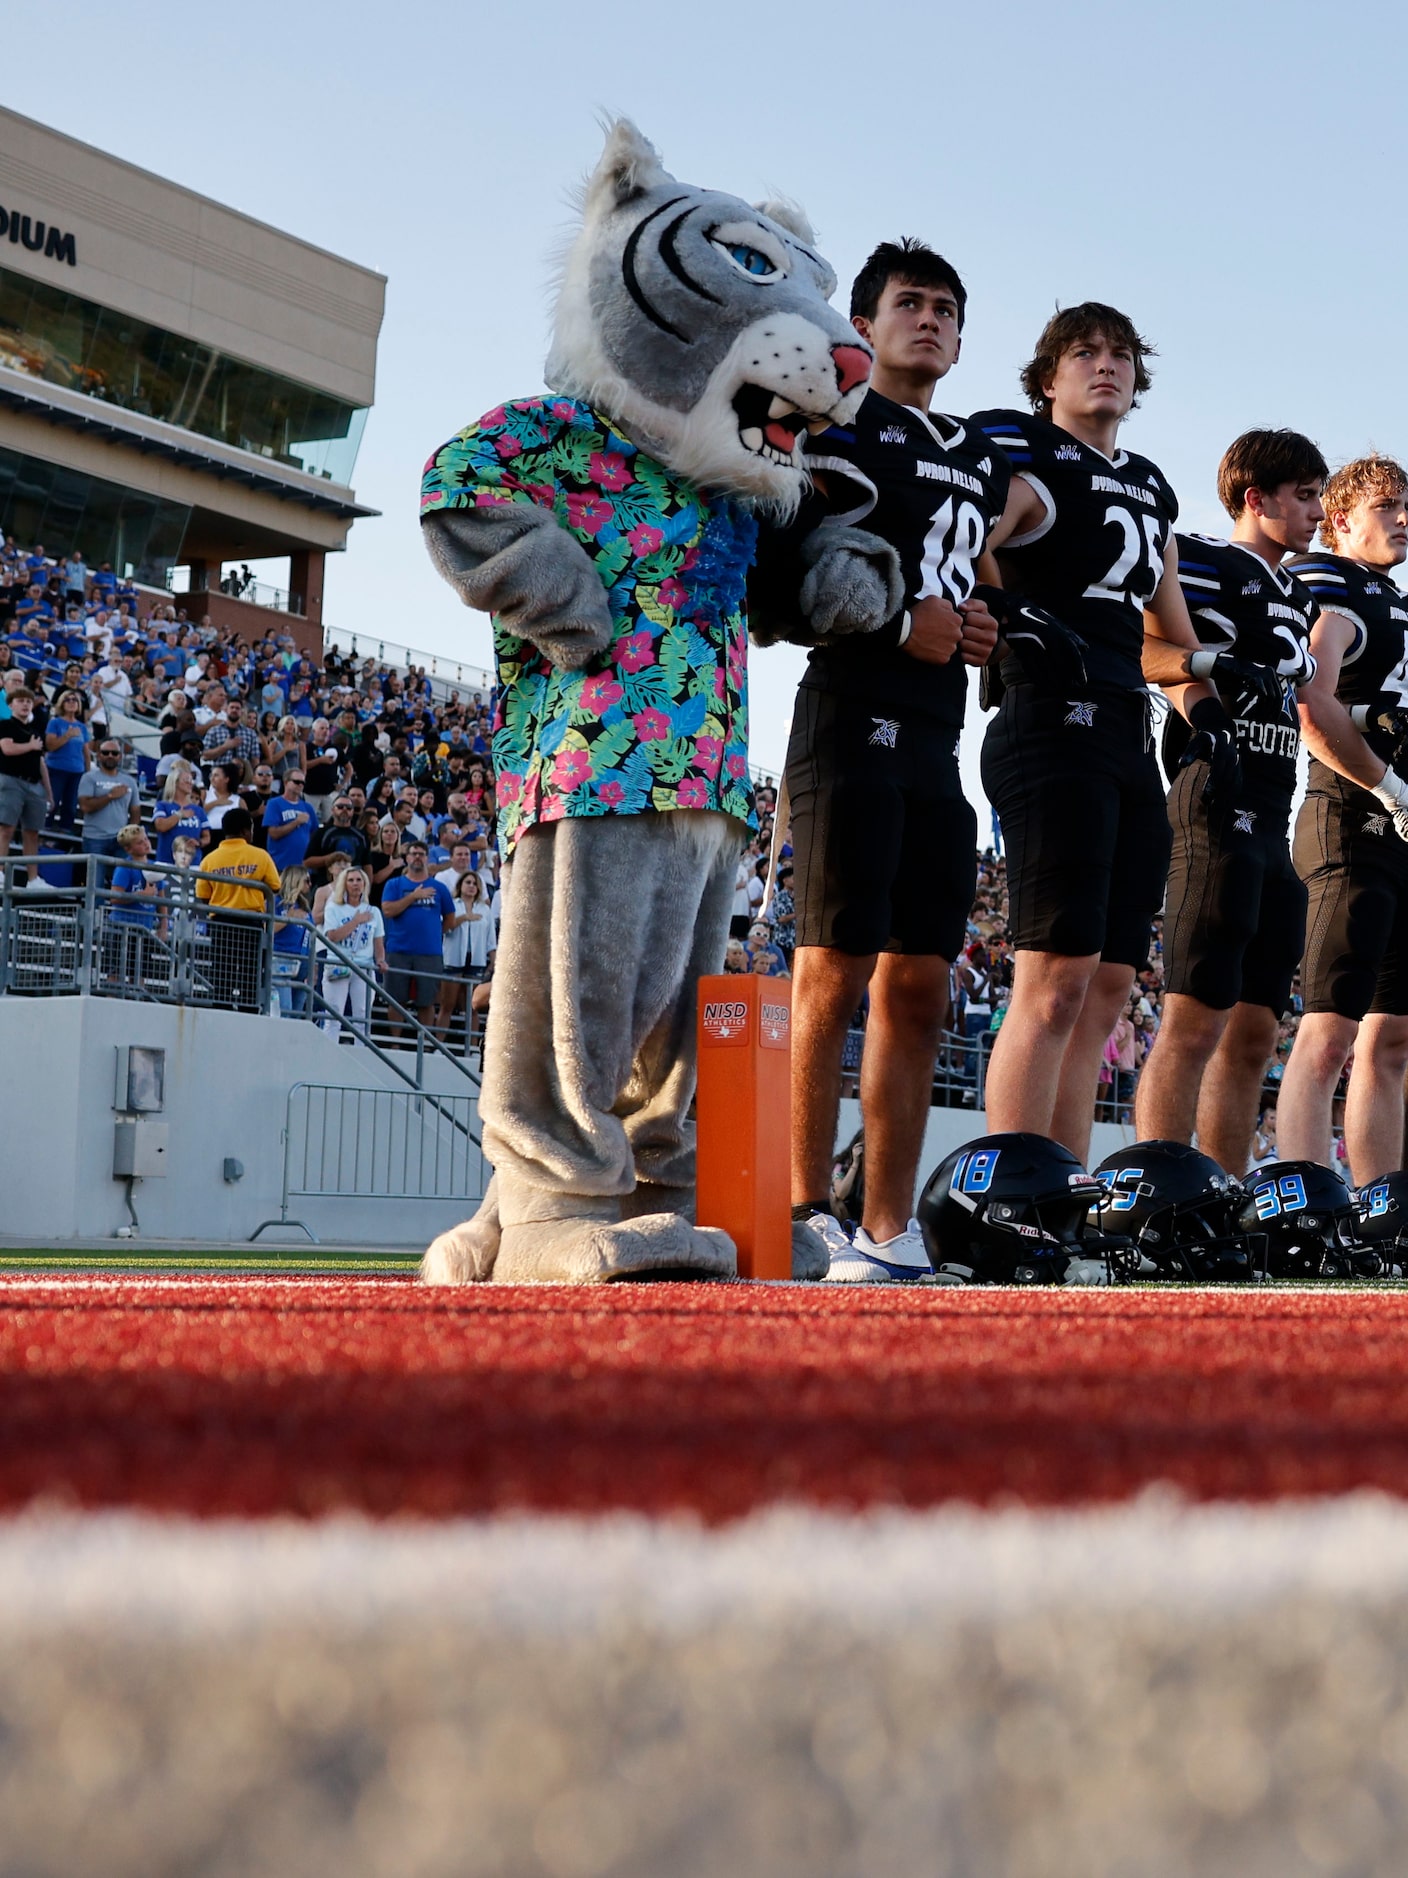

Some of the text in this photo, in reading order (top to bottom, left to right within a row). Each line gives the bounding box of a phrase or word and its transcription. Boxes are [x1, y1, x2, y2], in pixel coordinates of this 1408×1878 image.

[914, 494, 984, 608] 18
[1082, 505, 1164, 613] 25
[704, 1002, 747, 1020] NISD
[761, 1003, 789, 1022] NISD
[761, 1020, 788, 1029] ATHLETICS
[950, 1150, 1001, 1194] 18
[1254, 1174, 1307, 1221] 39
